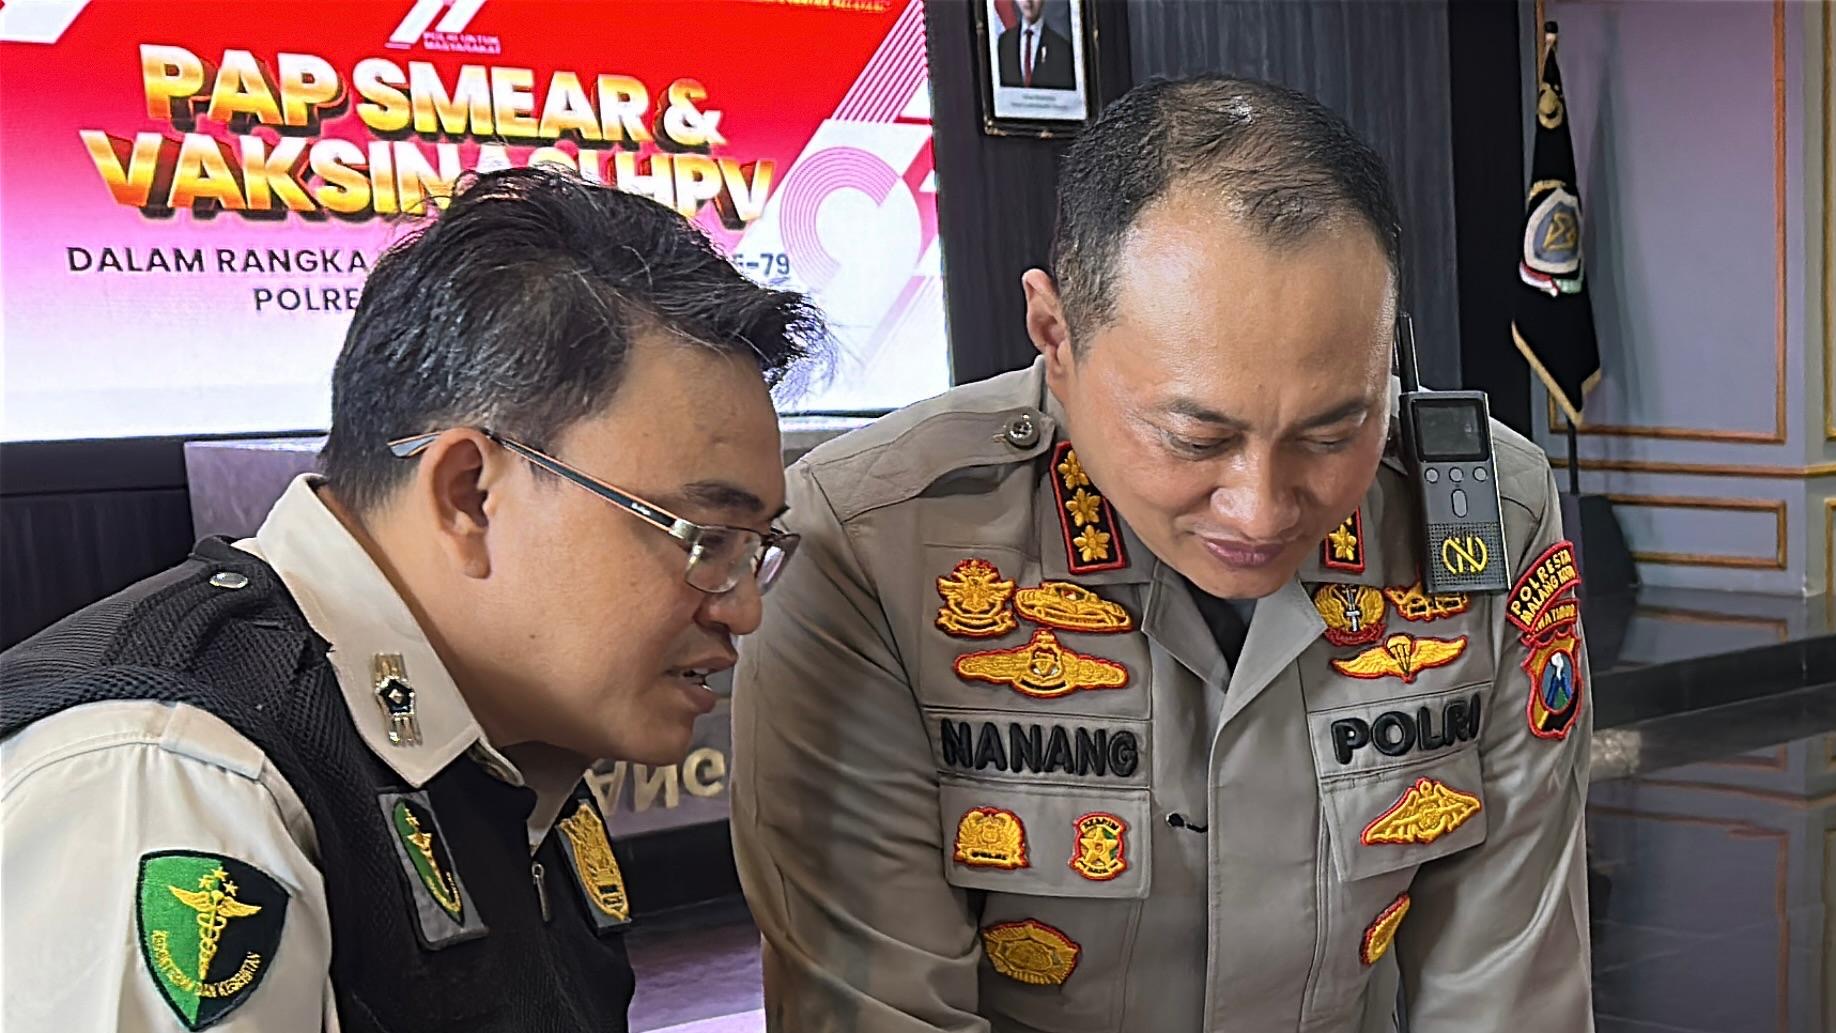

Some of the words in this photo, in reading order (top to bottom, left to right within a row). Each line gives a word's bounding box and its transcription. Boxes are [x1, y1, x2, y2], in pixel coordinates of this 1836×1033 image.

[139, 43, 345, 133] PAP
[352, 58, 655, 146] SMEAR
[661, 80, 726, 150] &
[78, 130, 605, 222] VAKSIN
[614, 150, 776, 228] HPV
[66, 246, 205, 273] DALAM
[216, 247, 369, 273] RANGKA
[254, 287, 360, 312] POLRE
[940, 717, 1139, 778] NANANG
[1330, 692, 1482, 765] POLRI
